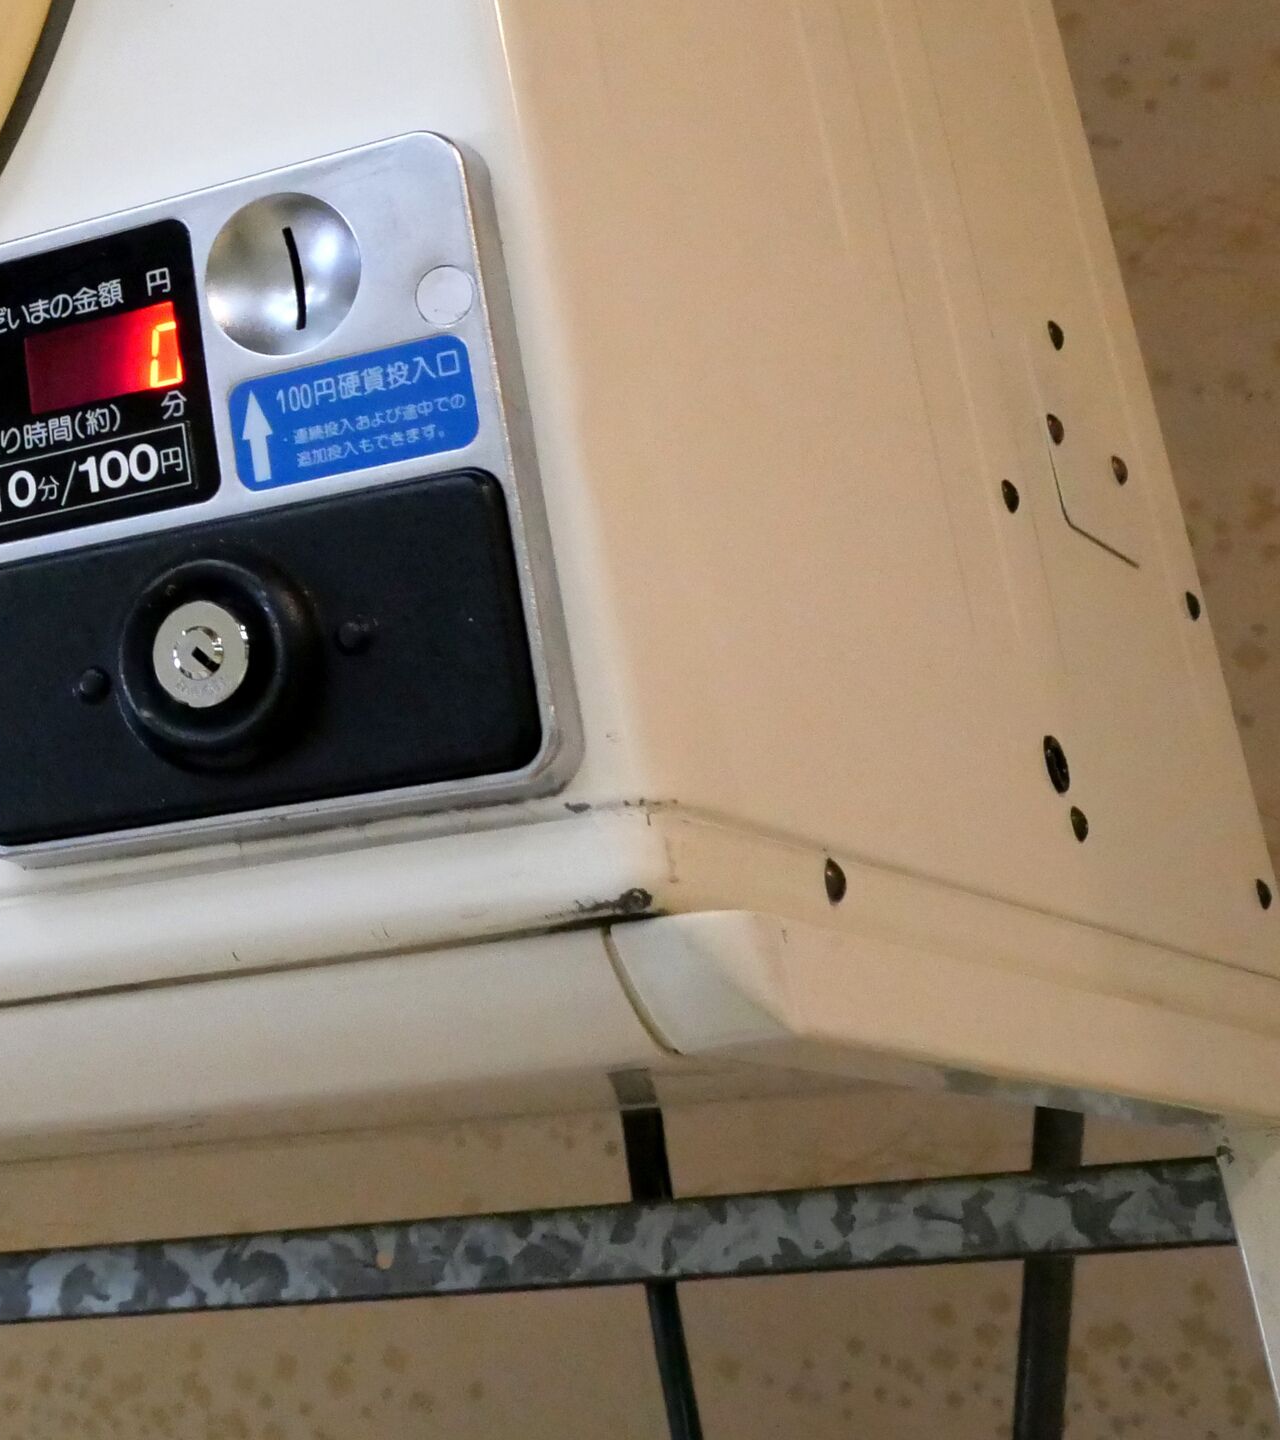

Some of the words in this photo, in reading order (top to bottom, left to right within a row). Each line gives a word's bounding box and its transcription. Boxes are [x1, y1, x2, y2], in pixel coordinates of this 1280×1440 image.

[146, 267, 171, 296] 円
[276, 350, 461, 414] 100円硬貨投入口
[161, 390, 187, 419] 分
[296, 424, 446, 468] 追加投入もできます。
